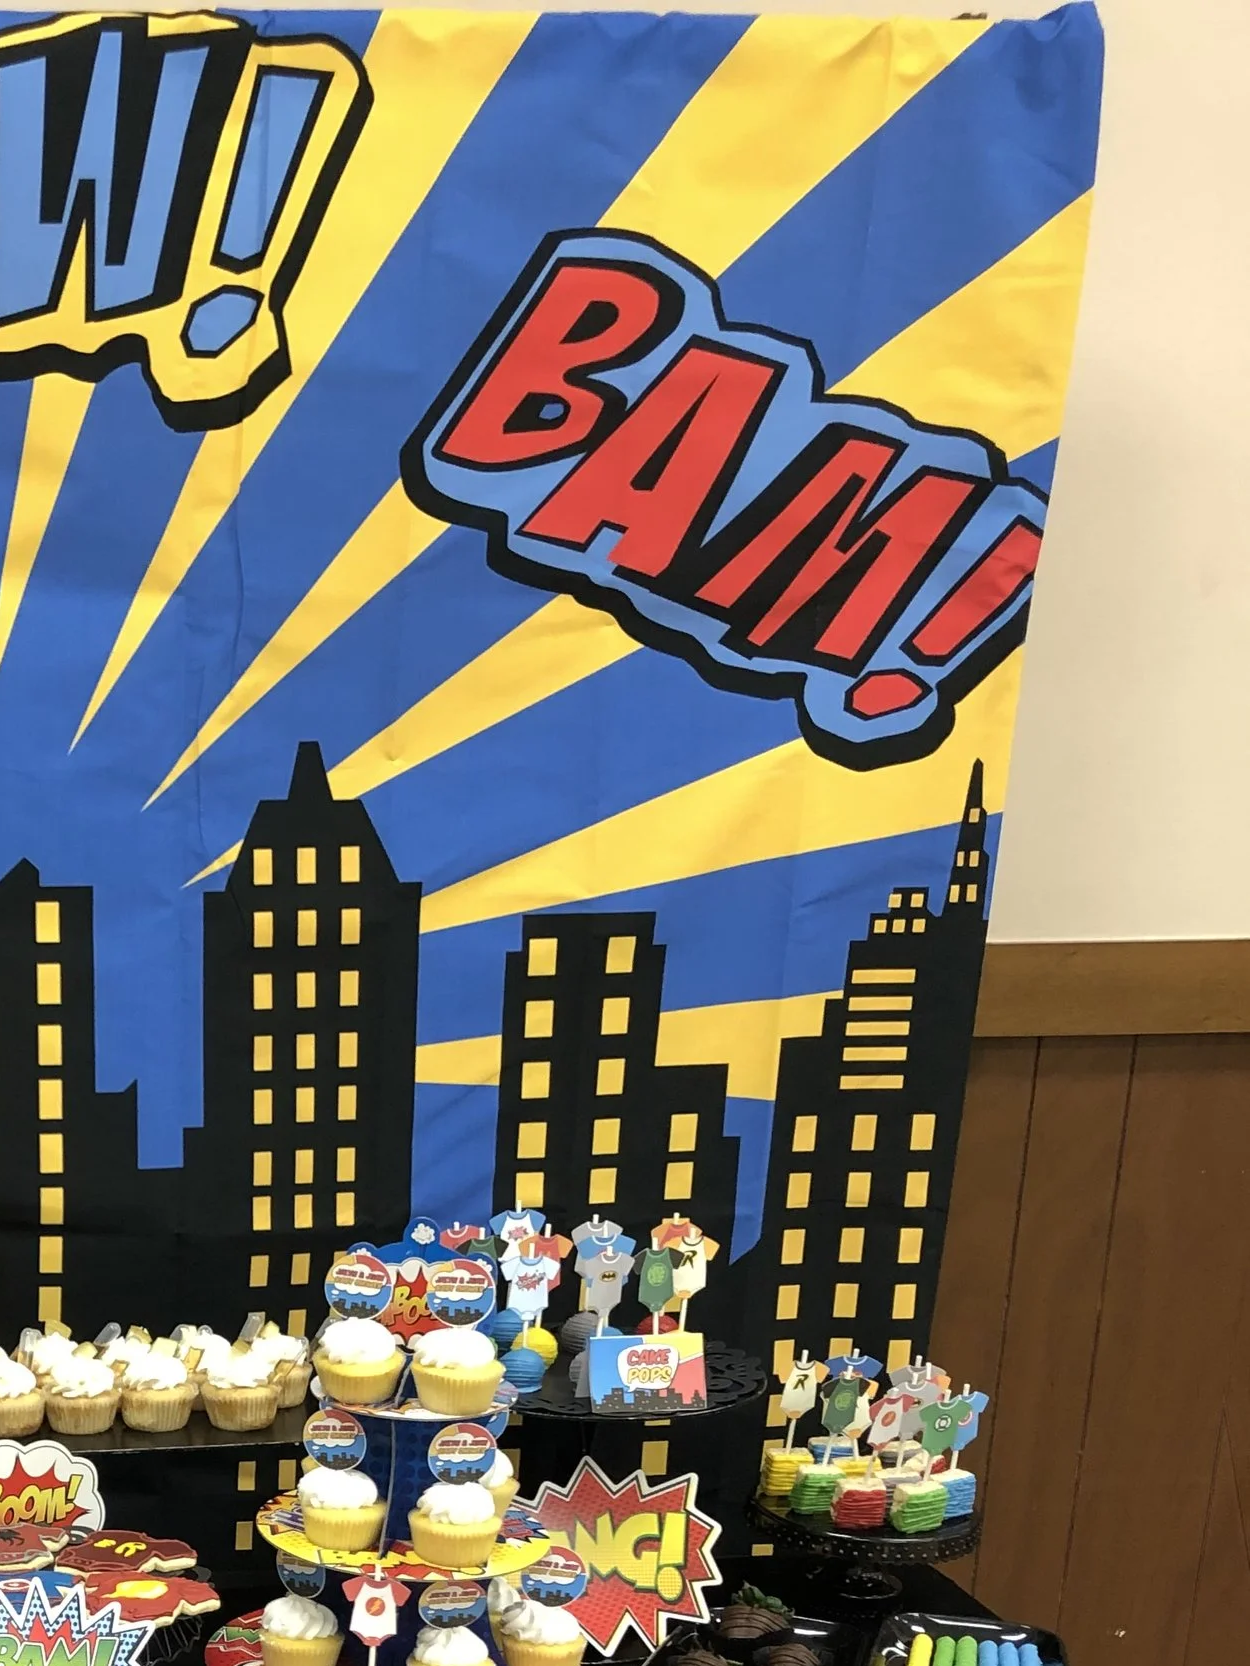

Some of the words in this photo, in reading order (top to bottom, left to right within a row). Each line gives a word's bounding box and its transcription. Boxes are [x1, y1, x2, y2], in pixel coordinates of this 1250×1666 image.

[430, 256, 1044, 721] BAM!
[626, 1348, 672, 1366] CAKE
[626, 1366, 672, 1384] POPS
